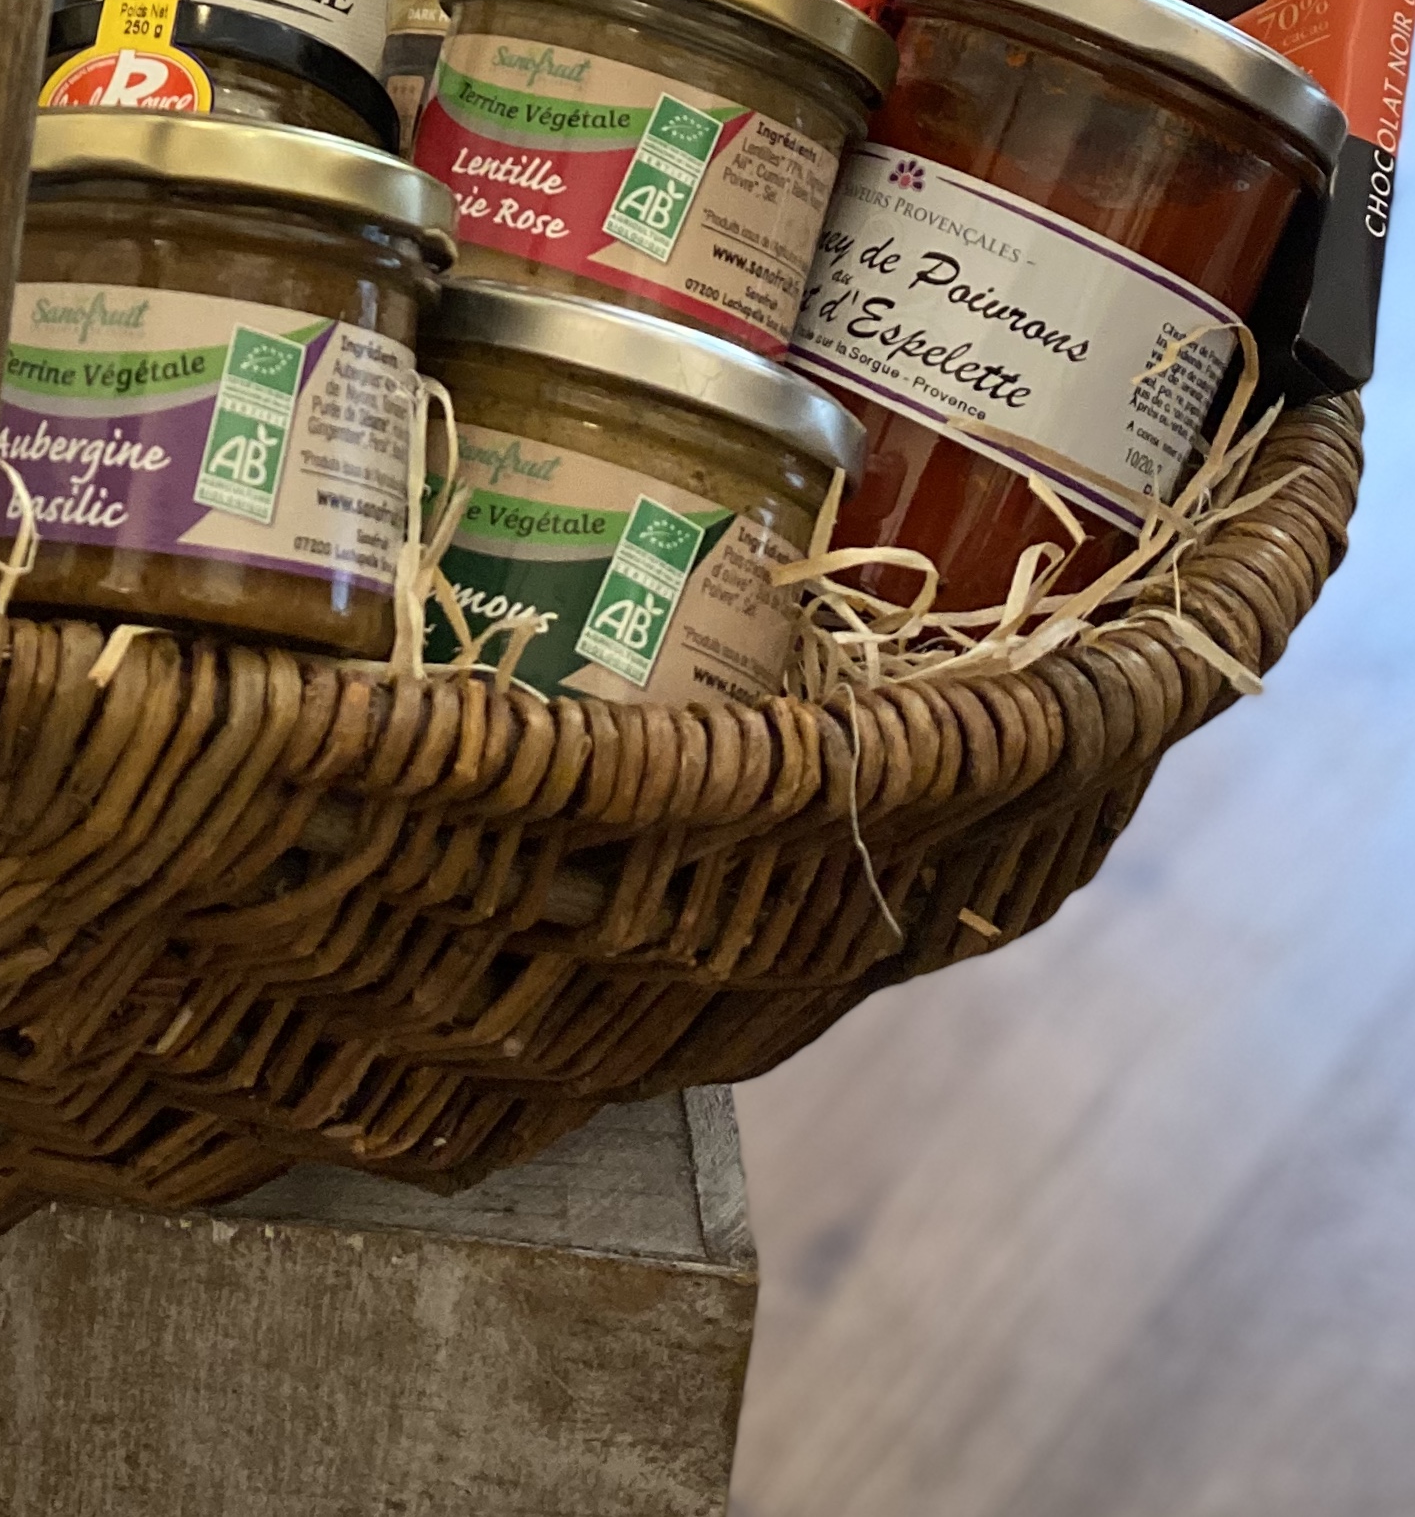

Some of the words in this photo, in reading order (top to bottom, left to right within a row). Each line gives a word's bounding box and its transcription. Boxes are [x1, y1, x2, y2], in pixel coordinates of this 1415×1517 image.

[123, 19, 150, 36] 250
[153, 23, 164, 39] g
[150, 3, 169, 20] Net
[457, 82, 520, 120] Terrine
[522, 104, 632, 134] Végétale
[1364, 76, 1404, 238] CHOCOLAT
[1386, 10, 1413, 77] NOIR
[450, 146, 569, 198] Lentille
[492, 196, 571, 241] Rose
[618, 183, 676, 231] AB
[893, 197, 1022, 264] PROVENÇALES
[831, 268, 854, 285] au
[859, 236, 902, 275] de
[909, 251, 1091, 364] Poivrons
[5, 349, 76, 388] errine
[82, 353, 206, 393] Végétale
[819, 288, 1032, 409] d'Espelette
[814, 331, 833, 349] sur
[836, 339, 848, 357] la
[848, 346, 901, 380] Sorgue
[911, 375, 987, 421] Provence
[208, 435, 269, 487] AB
[487, 506, 607, 538] Végétale
[594, 600, 655, 650] AB
